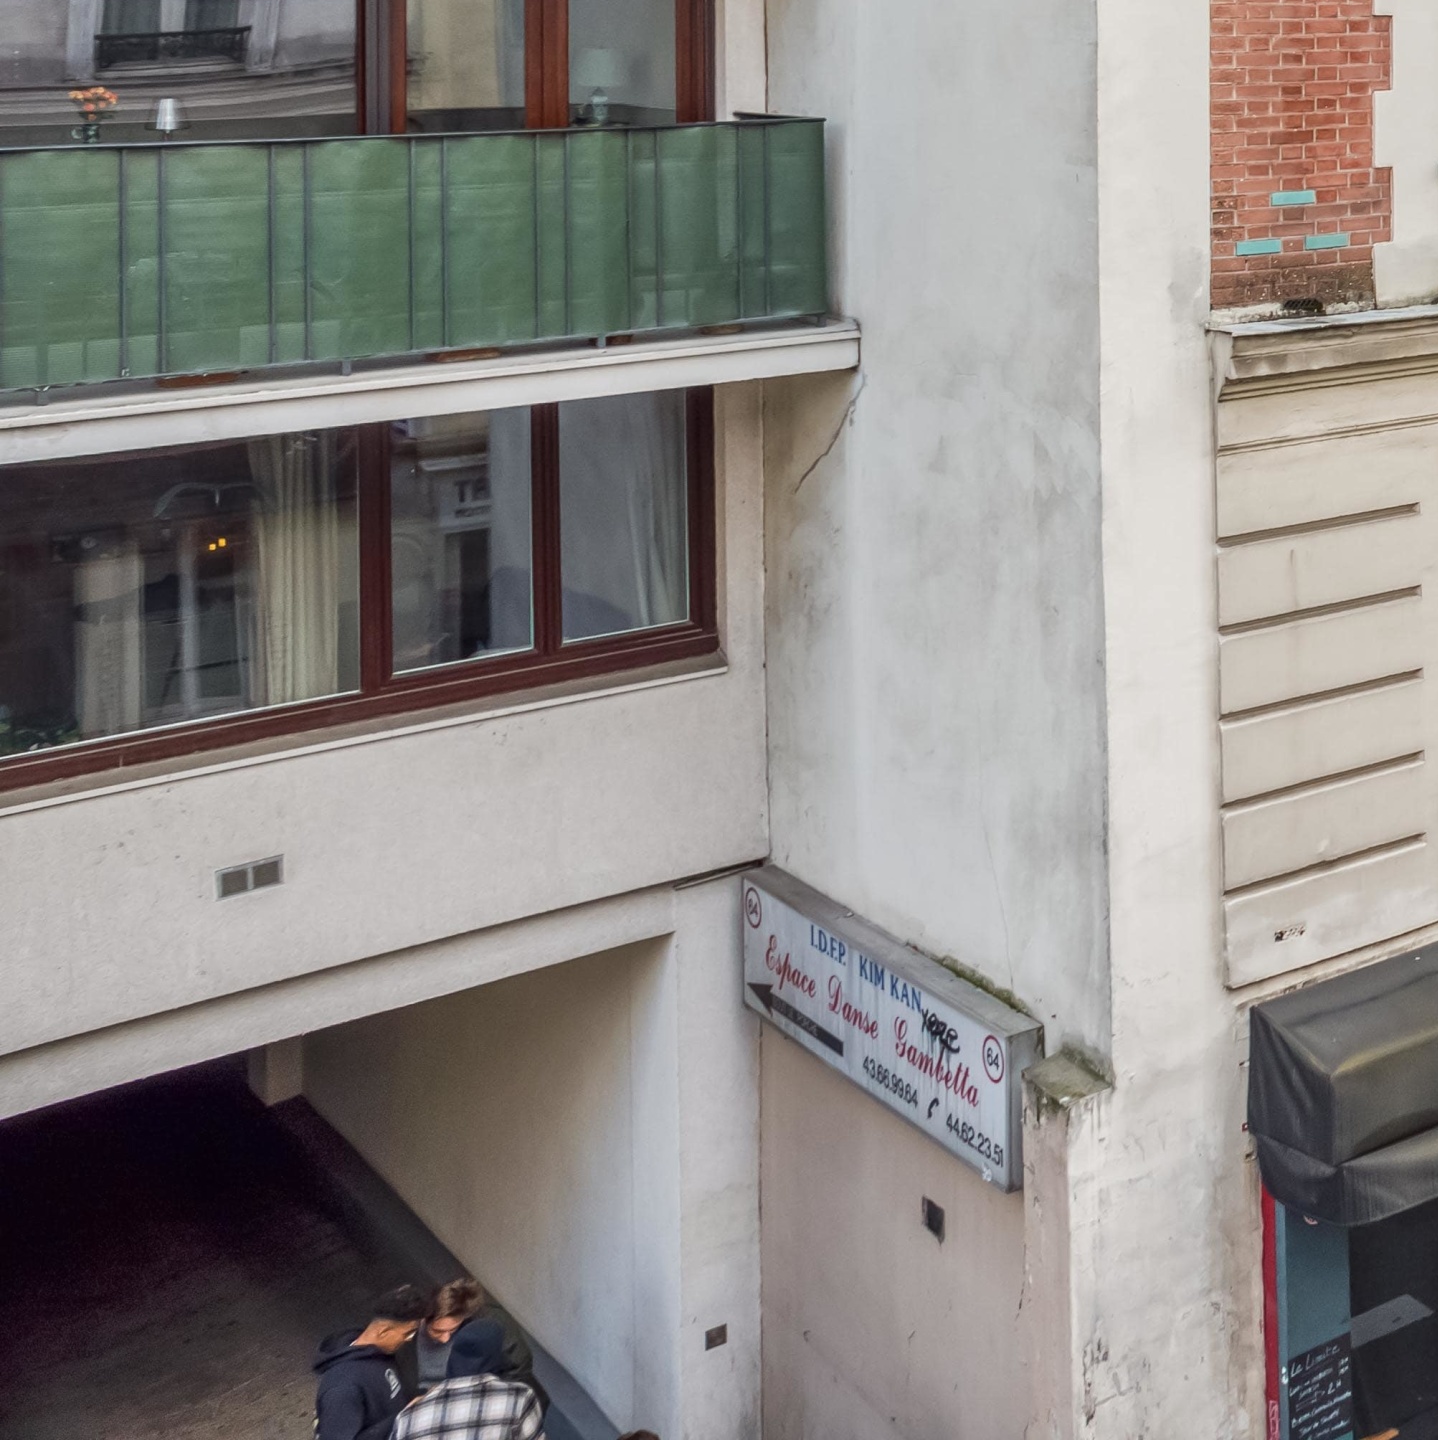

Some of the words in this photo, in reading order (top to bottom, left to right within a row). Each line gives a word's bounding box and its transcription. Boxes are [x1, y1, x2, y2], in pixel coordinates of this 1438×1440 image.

[859, 955, 885, 991] KIM
[765, 934, 816, 998] Espace
[828, 975, 878, 1039] Danse
[894, 1016, 979, 1107] Gambetta
[987, 1047, 999, 1070] 64
